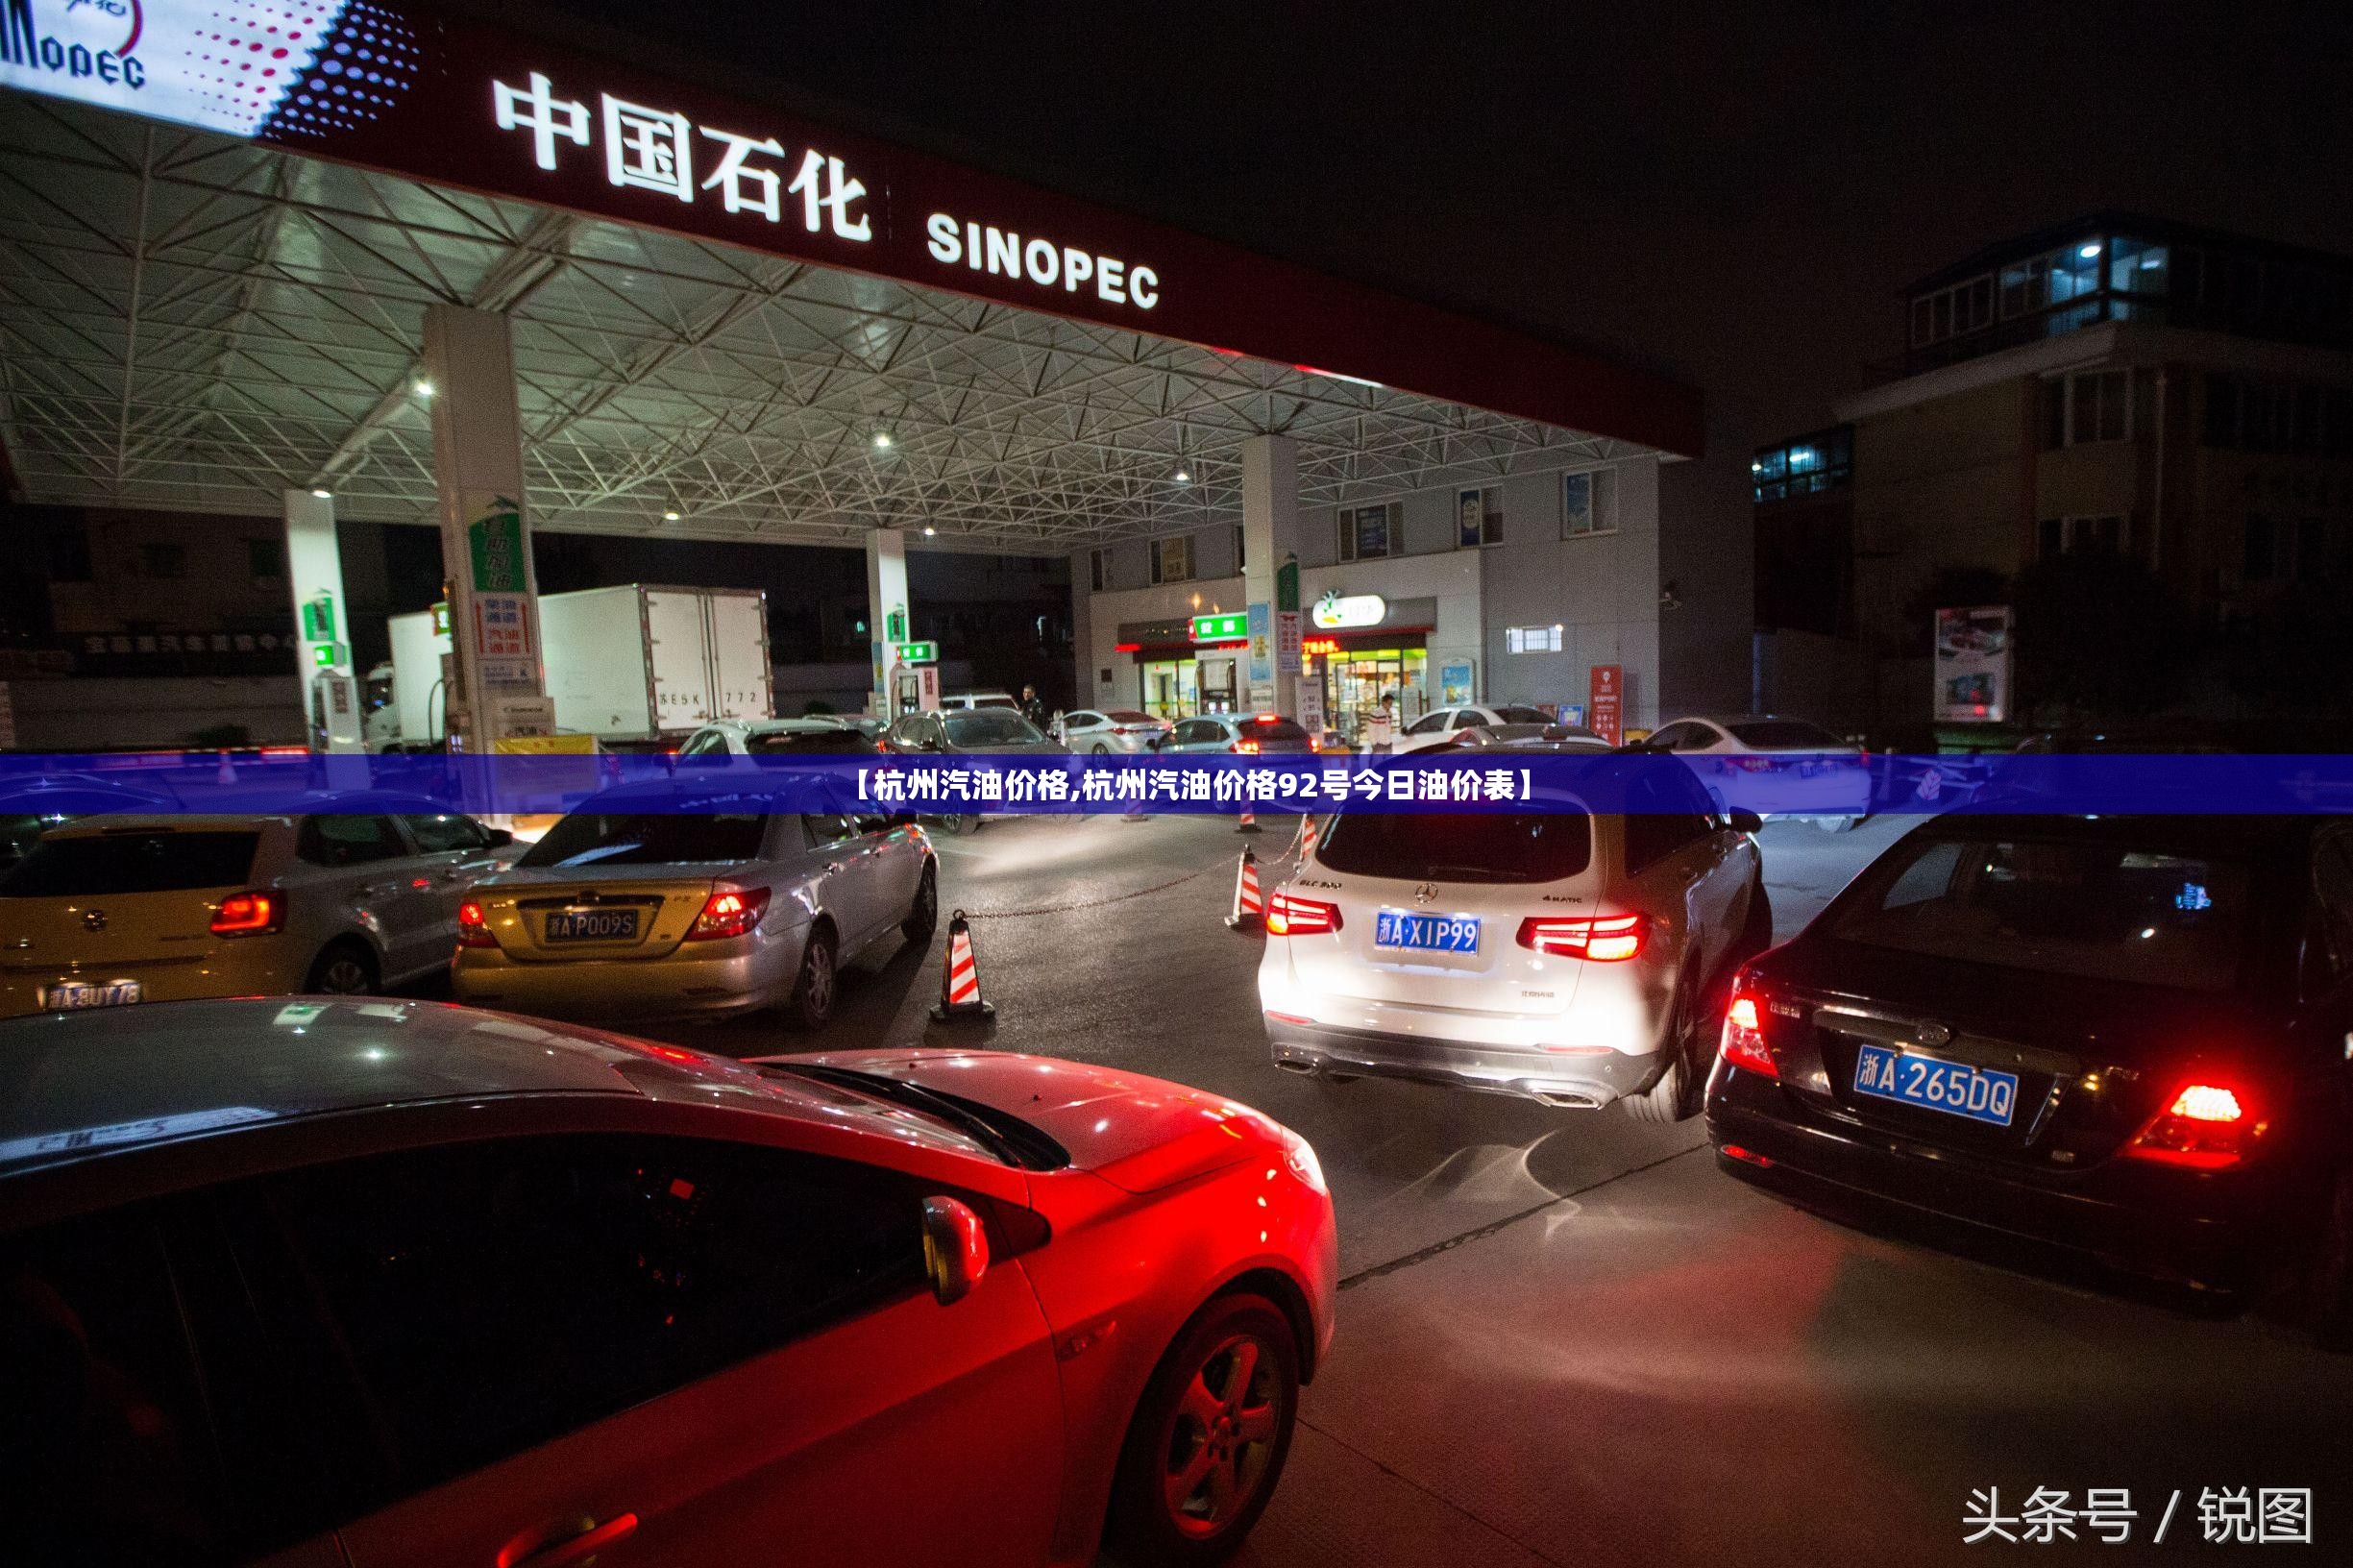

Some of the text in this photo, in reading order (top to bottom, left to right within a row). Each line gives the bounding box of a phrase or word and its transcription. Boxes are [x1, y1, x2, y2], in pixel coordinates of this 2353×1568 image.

[493, 71, 872, 243] 中国石化
[927, 212, 1160, 309] SINOPEC
[726, 692, 758, 703] 772
